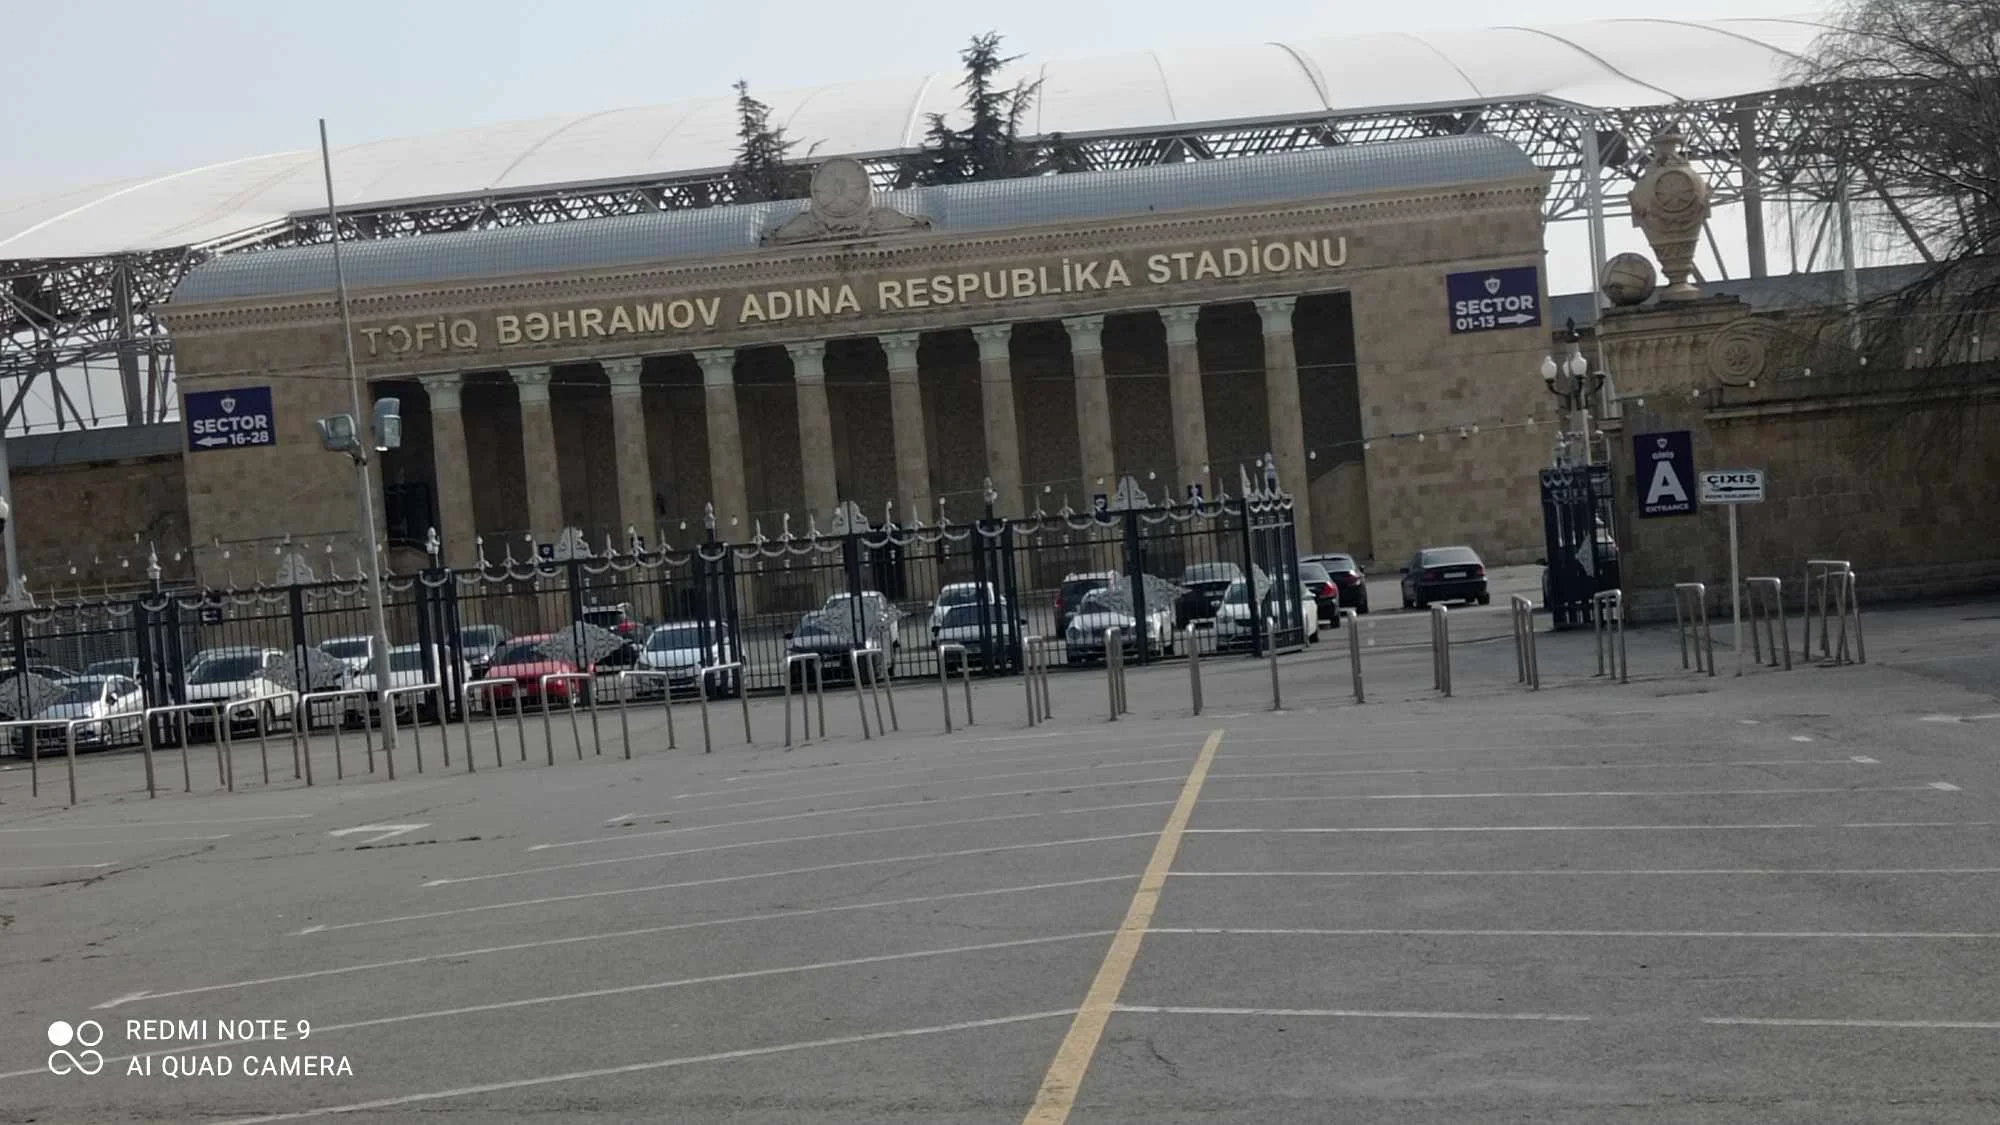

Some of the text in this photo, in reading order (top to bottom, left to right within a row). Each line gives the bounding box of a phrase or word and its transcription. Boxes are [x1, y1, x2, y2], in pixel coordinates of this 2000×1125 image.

[496, 296, 722, 343] BƏHRAMOV
[739, 284, 861, 323] ADINA
[878, 257, 1131, 311] RESPUBLİKA
[1147, 236, 1349, 284] STADİONU
[1455, 295, 1535, 316] SECTOR
[1456, 315, 1496, 331] 01-13
[193, 414, 268, 434] SECTOR
[229, 431, 270, 446] 16-28
[1646, 460, 1689, 504] A
[1645, 502, 1690, 513] ENTRANCE
